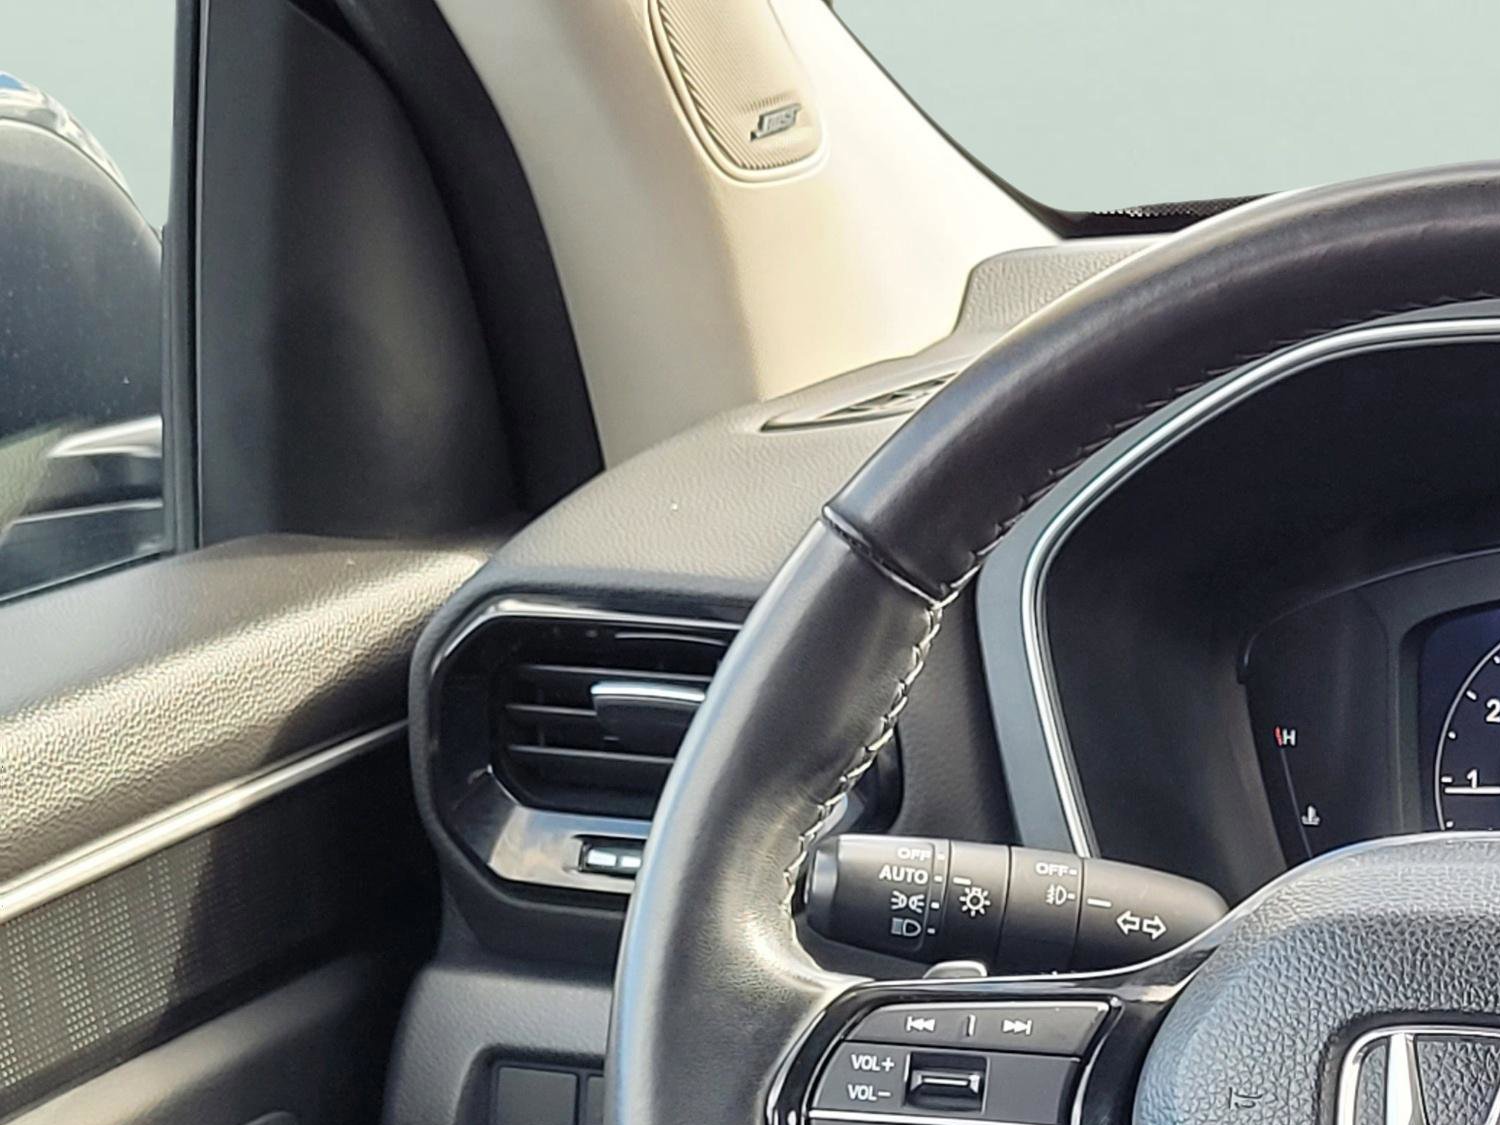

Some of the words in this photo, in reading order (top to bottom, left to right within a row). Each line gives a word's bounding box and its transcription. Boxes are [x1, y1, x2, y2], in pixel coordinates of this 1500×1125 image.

[1466, 769, 1478, 789] 1
[897, 847, 931, 861] OFF
[878, 864, 929, 885] AUTO
[1035, 861, 1069, 877] OFF
